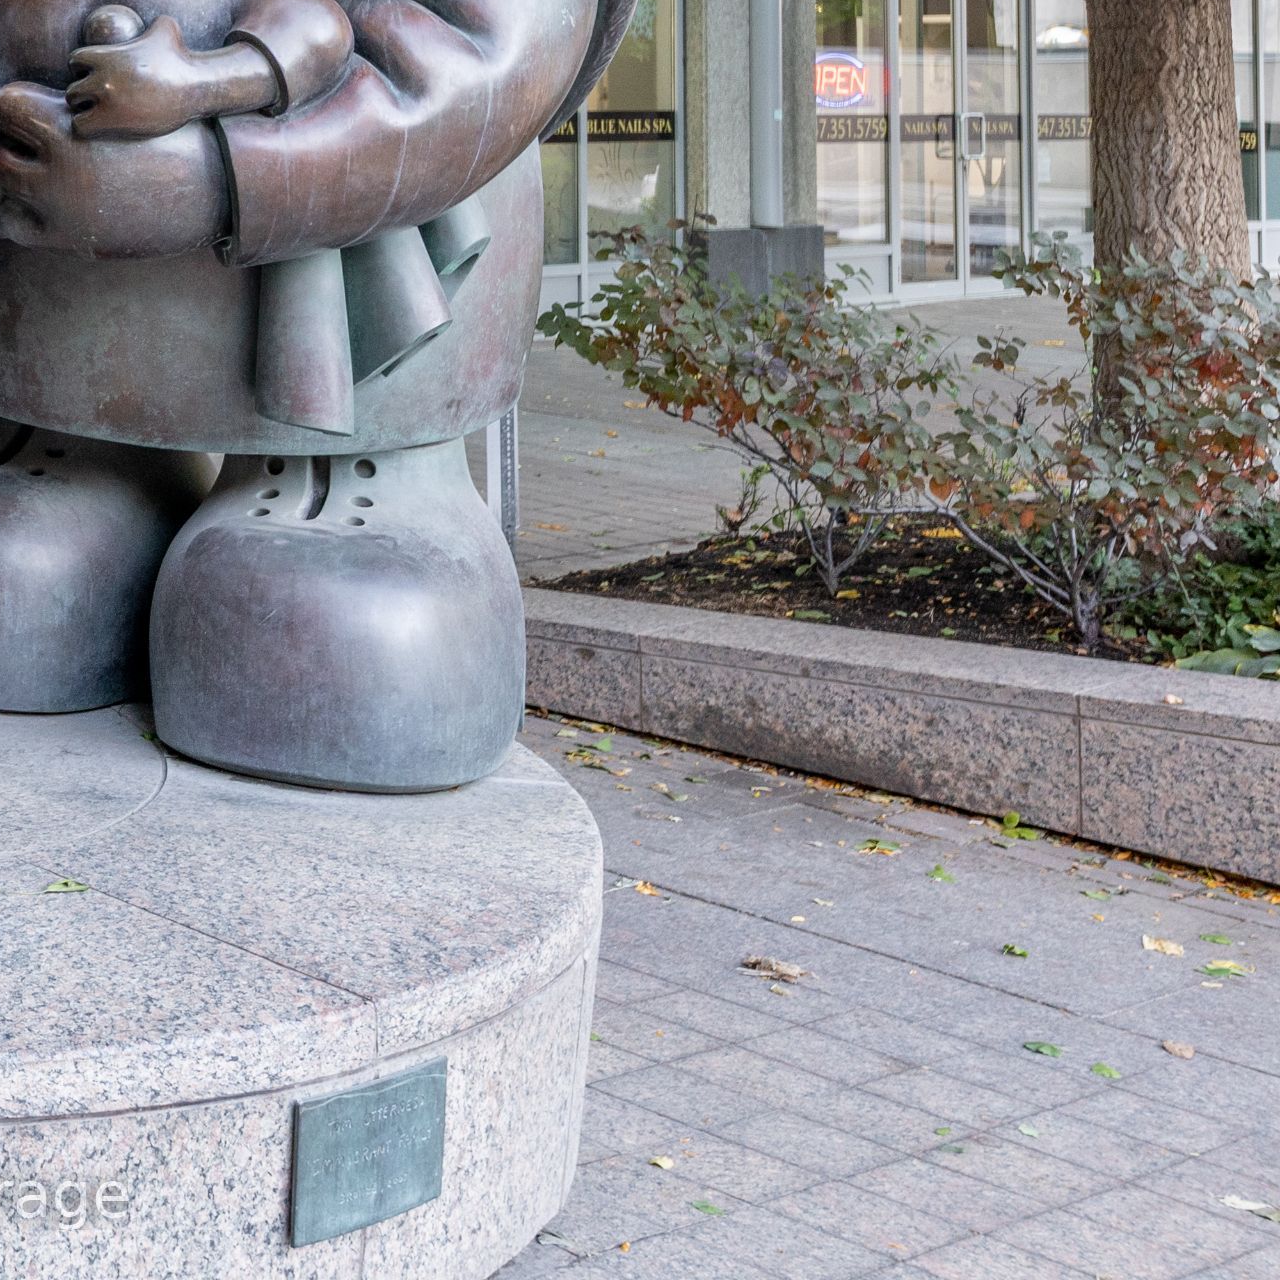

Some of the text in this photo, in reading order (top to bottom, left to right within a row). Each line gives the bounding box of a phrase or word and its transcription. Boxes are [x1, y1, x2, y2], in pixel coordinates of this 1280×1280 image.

[587, 119, 672, 134] BLUE NAILS SPA
[817, 118, 887, 140] 7.351.5759
[972, 121, 997, 135] NLS
